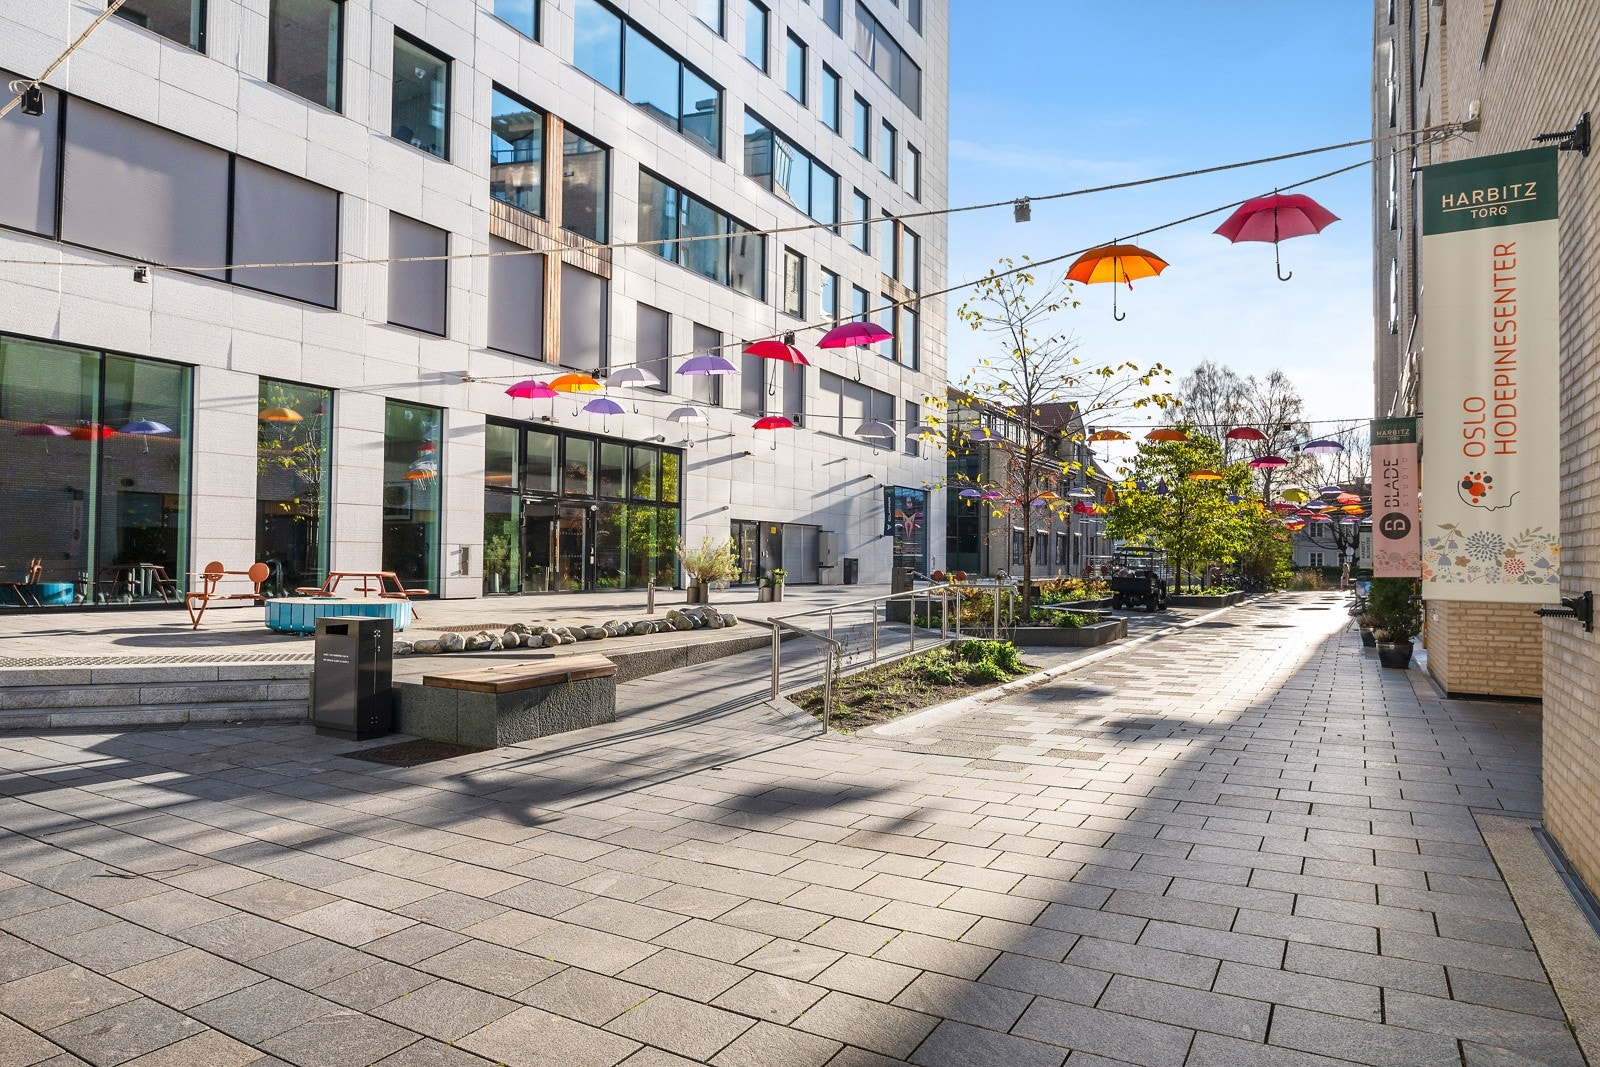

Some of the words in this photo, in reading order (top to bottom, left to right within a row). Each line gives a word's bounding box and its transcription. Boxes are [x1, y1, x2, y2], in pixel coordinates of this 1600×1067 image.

[1442, 181, 1537, 208] HARBITZ
[1470, 206, 1508, 219] TORG
[1494, 241, 1517, 455] HODEPINESENTER
[1376, 428, 1410, 436] HARBITZ
[1463, 396, 1486, 457] OSLO
[1383, 458, 1400, 507] BLADE
